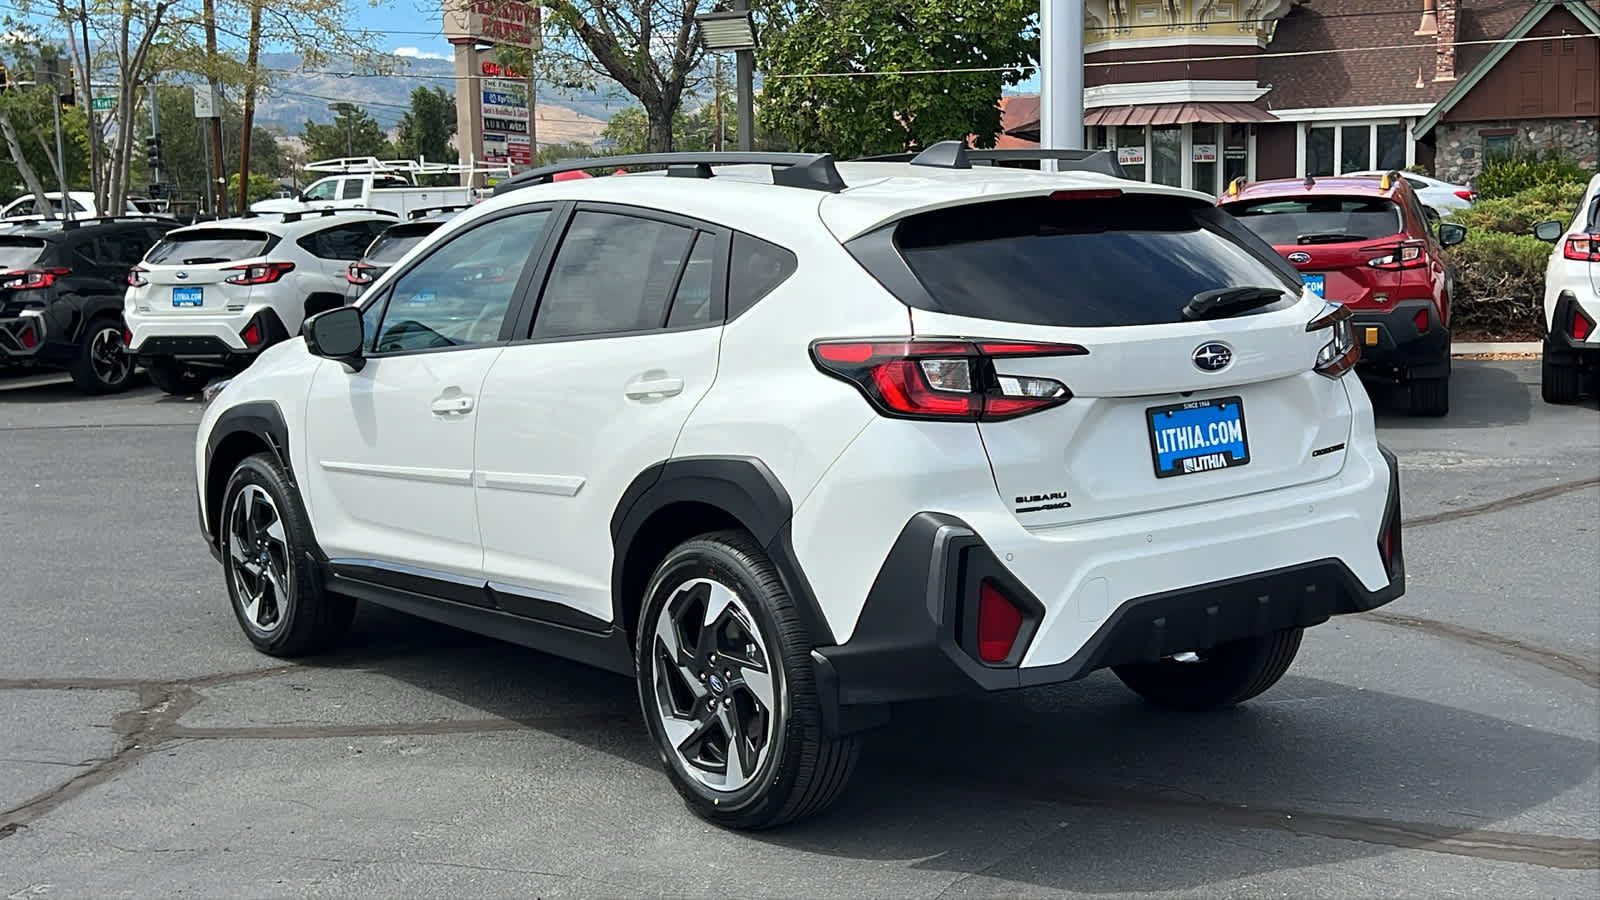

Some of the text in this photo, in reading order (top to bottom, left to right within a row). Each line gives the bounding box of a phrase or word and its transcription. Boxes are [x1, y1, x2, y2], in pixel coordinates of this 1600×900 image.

[1155, 418, 1243, 454] LITHIA.COM
[1193, 453, 1228, 471] LITHIA
[1015, 491, 1067, 503] SUBARU
